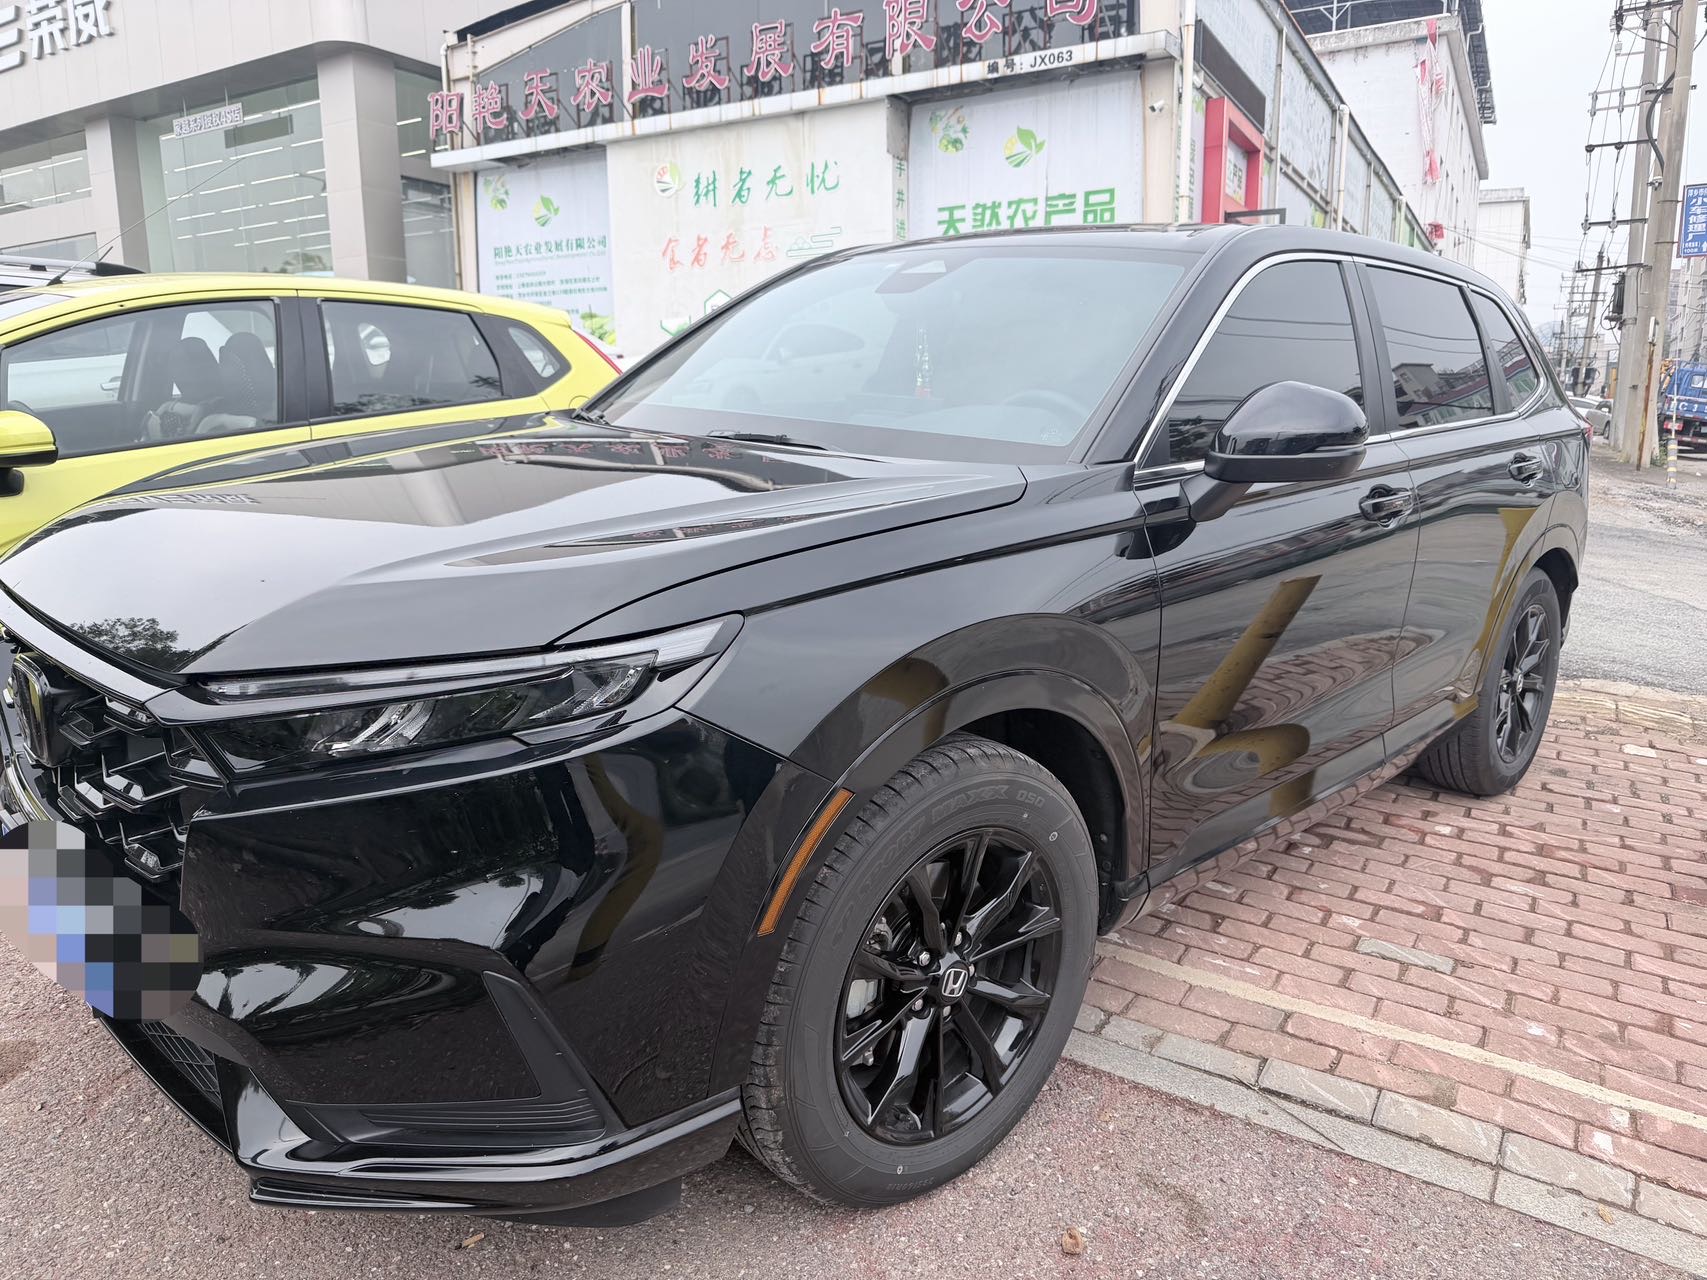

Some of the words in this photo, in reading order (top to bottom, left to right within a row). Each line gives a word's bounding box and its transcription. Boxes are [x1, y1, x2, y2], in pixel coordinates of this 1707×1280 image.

[937, 187, 1116, 236] 天然农产品
